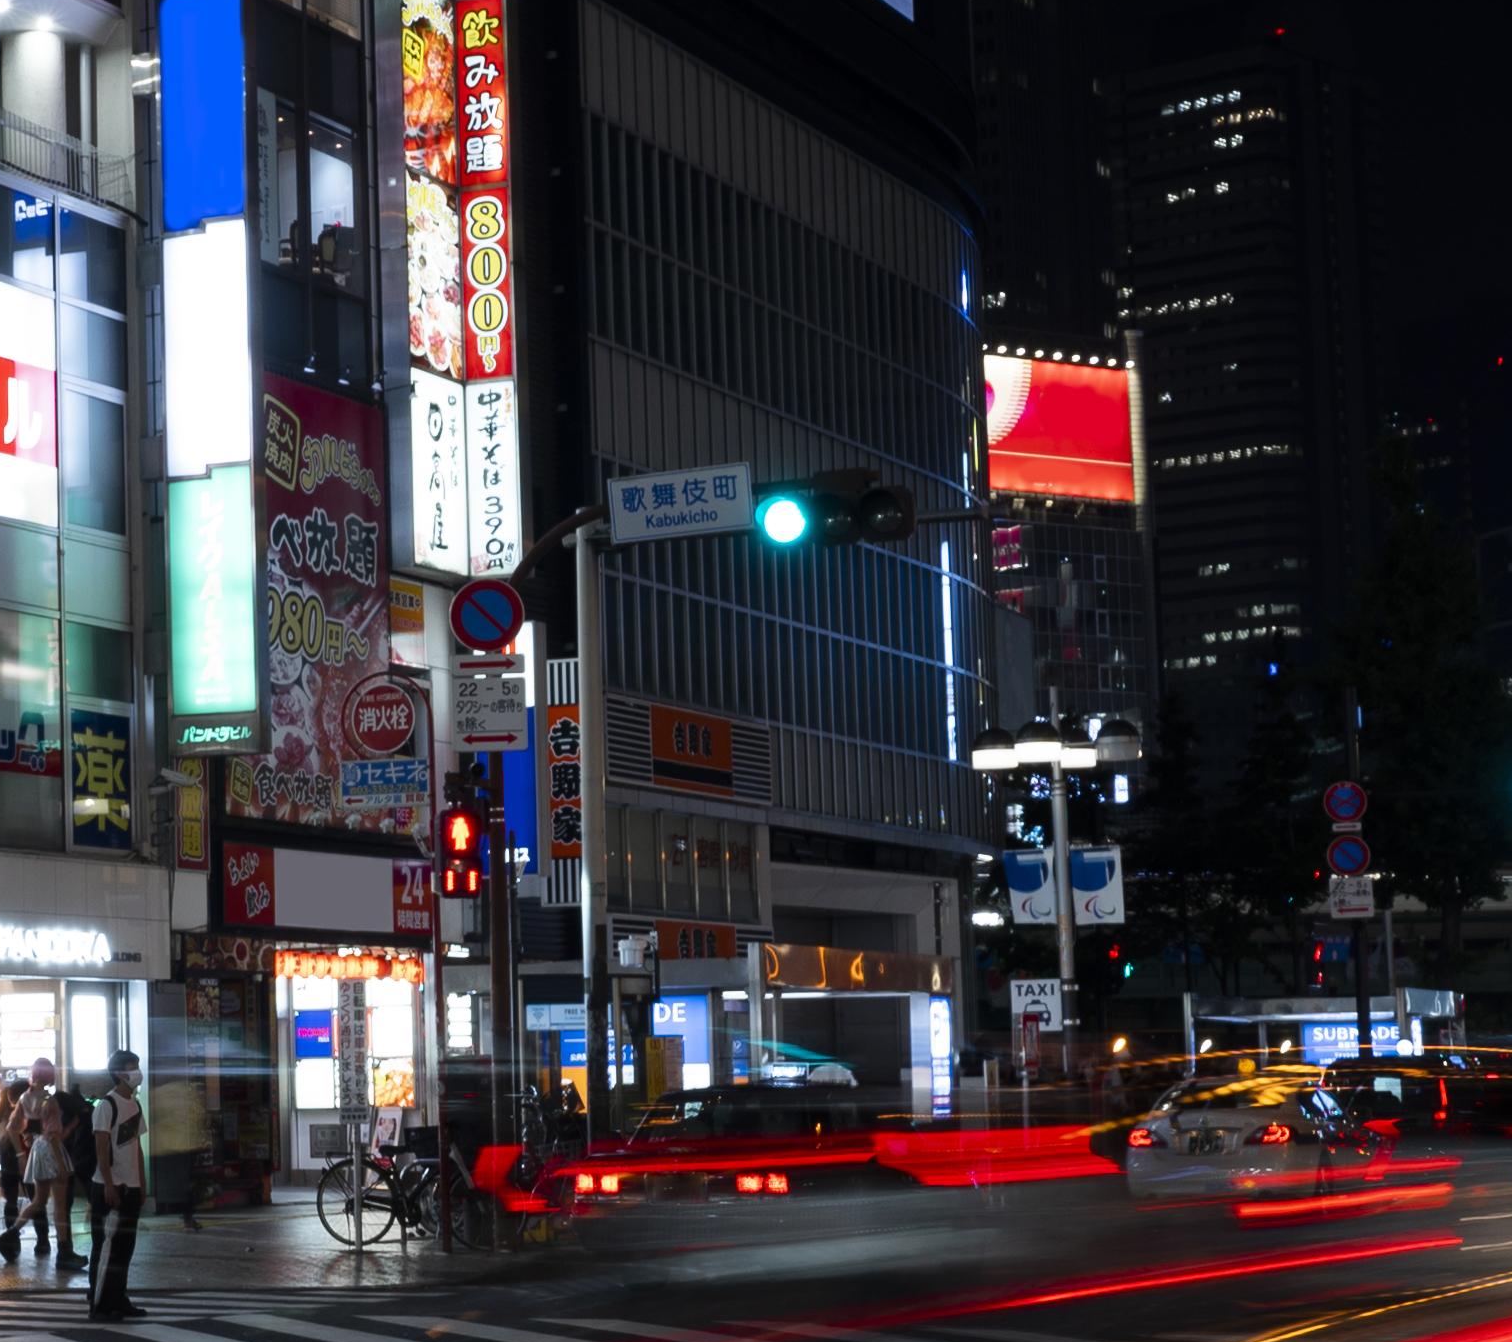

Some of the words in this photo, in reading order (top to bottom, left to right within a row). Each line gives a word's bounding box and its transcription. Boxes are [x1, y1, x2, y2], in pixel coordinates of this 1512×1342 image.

[462, 9, 504, 175] 飲み放題
[621, 474, 738, 513] 歌舞伎町
[645, 508, 718, 530] Kabukicho
[459, 682, 477, 697] 22
[358, 705, 410, 735] 消火栓
[455, 699, 524, 715] タクシーの客待ち
[177, 724, 252, 746] パンドラビル
[456, 716, 487, 732] を除く
[672, 720, 713, 759] 吉野家
[73, 725, 130, 832] 薬
[254, 761, 333, 810] 食べ放題
[362, 761, 428, 783] セキネ
[549, 716, 582, 846] 吉野家
[227, 851, 260, 887] ちょい
[400, 865, 425, 906] 24
[244, 881, 271, 919] 飲み
[396, 909, 431, 930] 時間営業
[1015, 982, 1056, 999] TAXI
